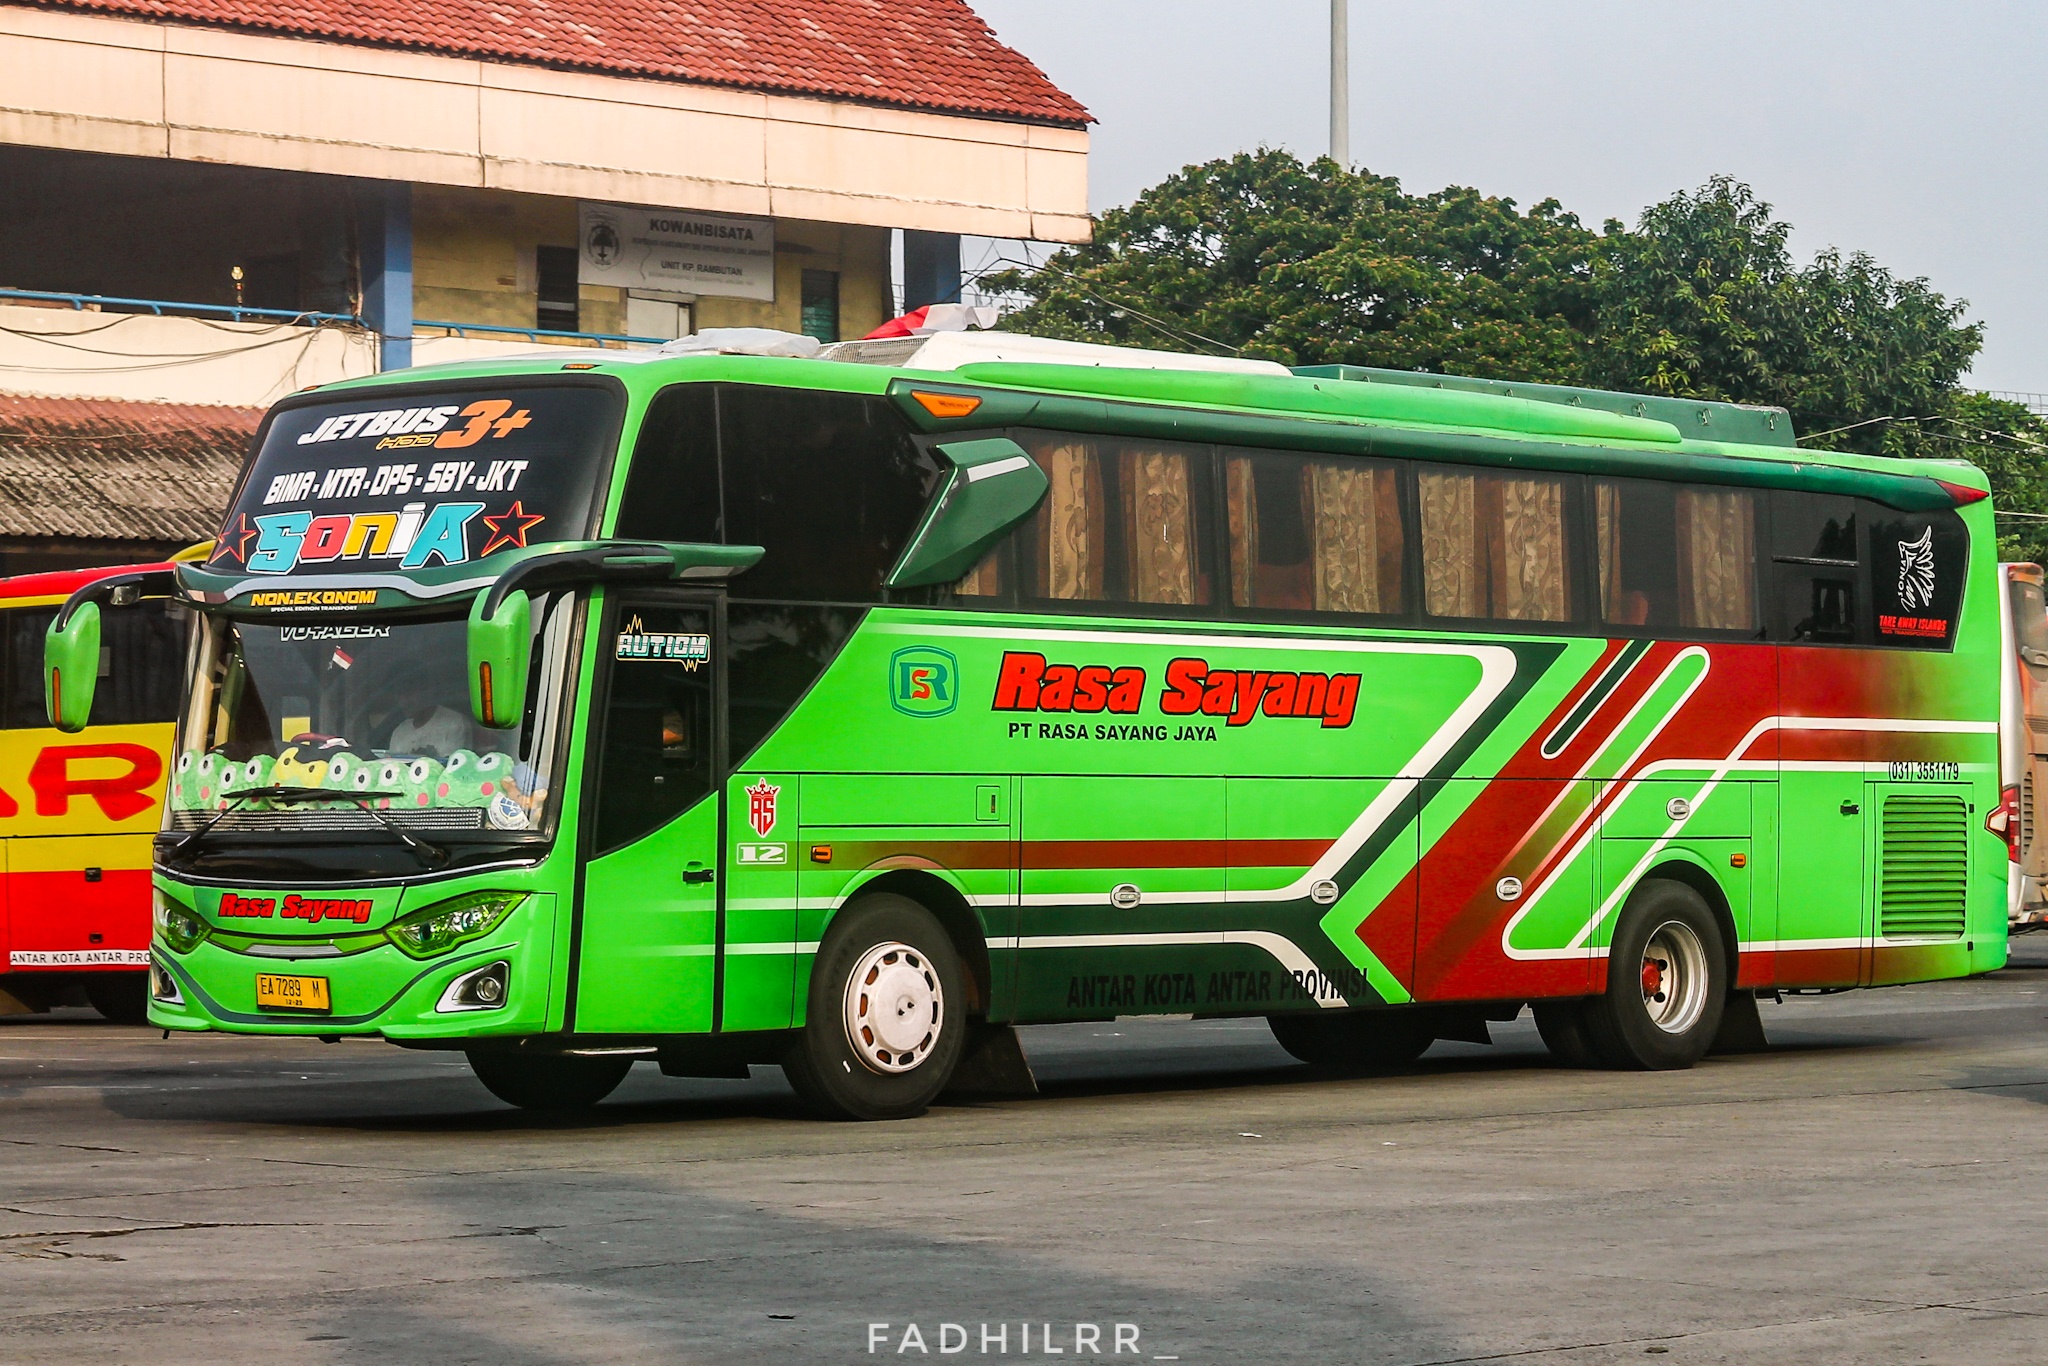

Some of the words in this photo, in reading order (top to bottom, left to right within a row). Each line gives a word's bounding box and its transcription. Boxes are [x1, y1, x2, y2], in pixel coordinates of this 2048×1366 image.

[650, 218, 754, 242] KOWANBISATA
[660, 260, 680, 271] UNIT
[697, 263, 743, 276] RAMBUTAN
[270, 605, 294, 613] SPECIAL
[321, 604, 358, 612] TRANSPORT
[1879, 614, 1897, 628] TAKE
[1897, 616, 1918, 629] AWAY
[1918, 618, 1947, 632] ISLANDS
[991, 650, 1146, 715] Rasa
[1160, 656, 1364, 729] Sayang
[1008, 722, 1033, 739] PT
[1039, 723, 1089, 740] RASA
[1094, 725, 1168, 742] SAYANG
[1173, 726, 1218, 742] JAYA
[1888, 760, 1914, 782] (031)
[1917, 761, 1959, 780] 3551179
[740, 845, 786, 862] 12
[218, 893, 277, 920] Rasa
[280, 894, 374, 924] Sayang
[11, 953, 47, 964] ANTAR
[52, 953, 81, 963] KOTA
[86, 952, 122, 962] ANTAR
[260, 977, 274, 995] EA
[276, 977, 301, 997] 7289
[312, 980, 321, 998] M
[1067, 974, 1136, 1008] ANTAR
[1143, 972, 1196, 1006] KOTA
[1206, 970, 1272, 1004] ANTAR
[1280, 967, 1368, 1001] PROVINSI
